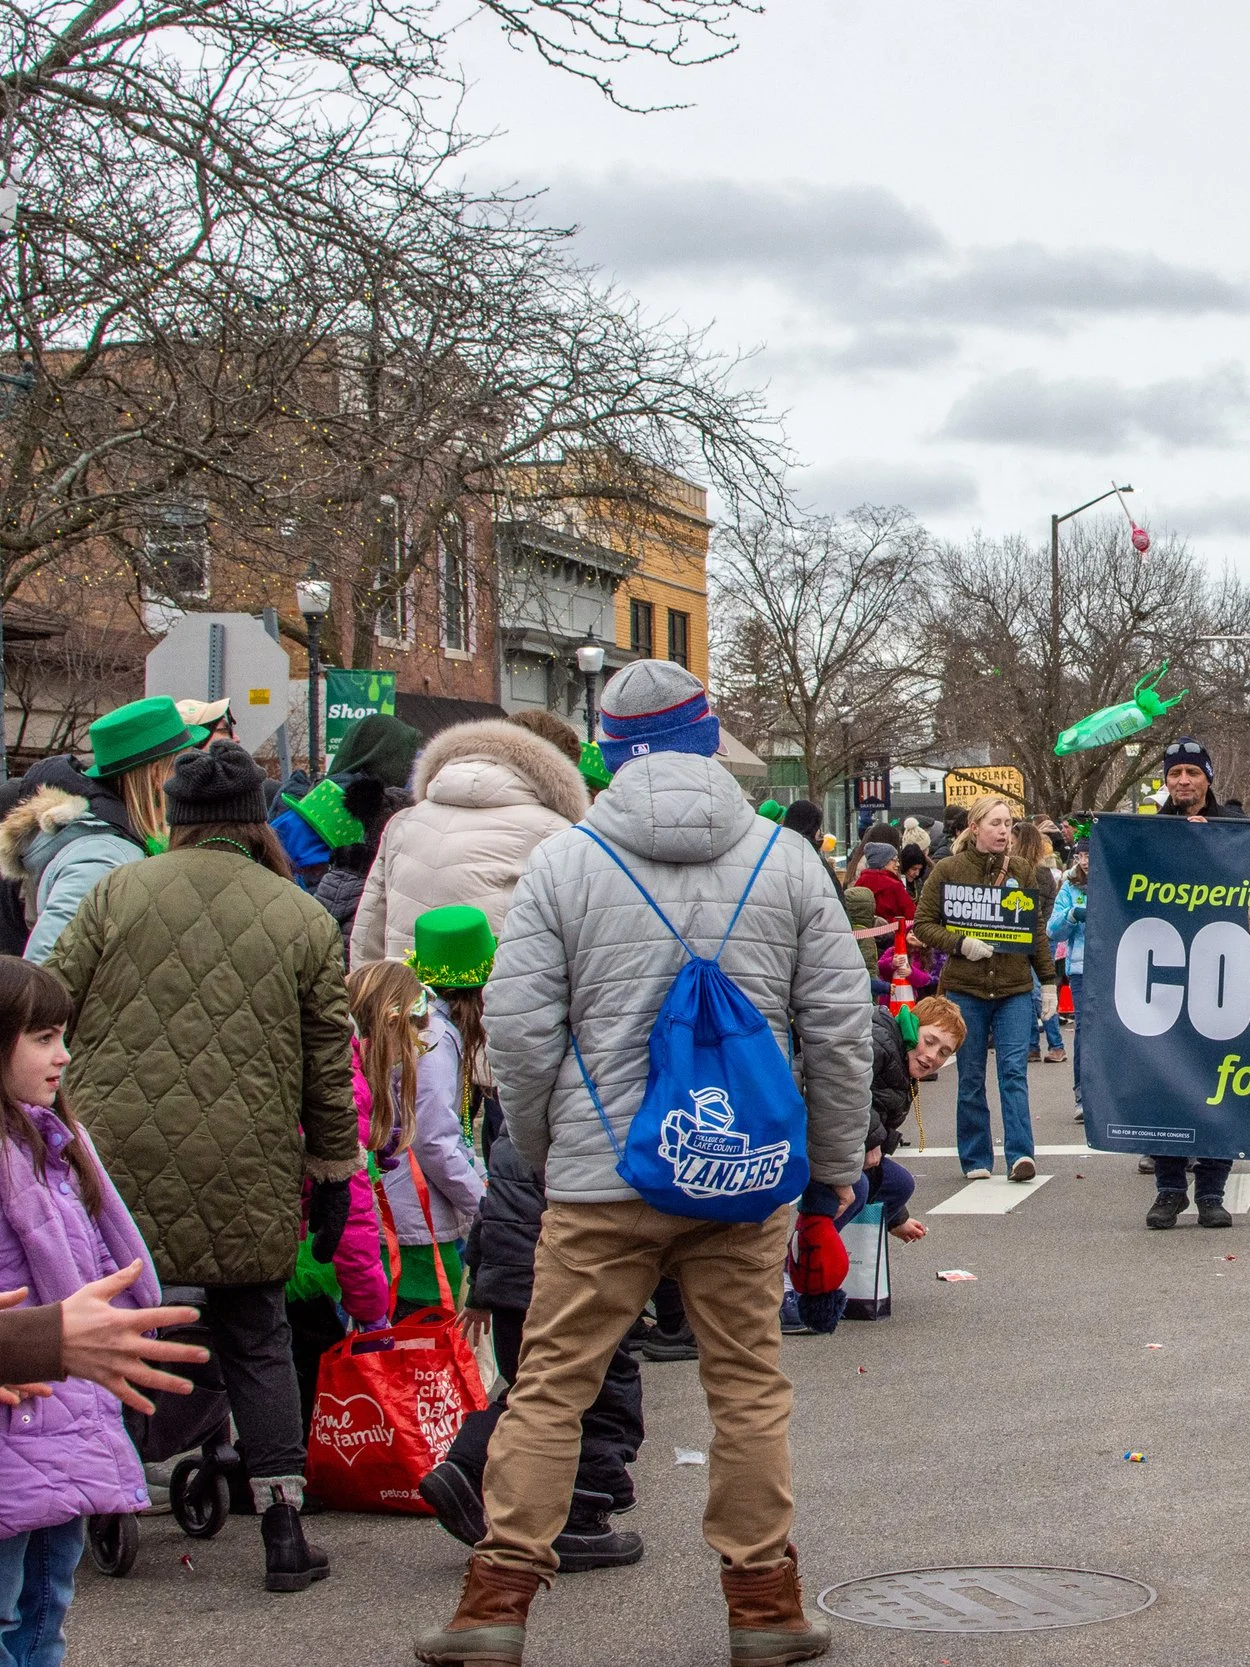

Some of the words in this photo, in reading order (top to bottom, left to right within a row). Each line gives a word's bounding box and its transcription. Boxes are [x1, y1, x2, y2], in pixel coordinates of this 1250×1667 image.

[949, 785, 977, 796] FEED
[944, 884, 1002, 904] MORGAN
[944, 900, 1004, 922] COGHILL
[972, 930, 994, 938] TUESDAY
[994, 932, 1012, 940] MARCH
[695, 1134, 719, 1143] COLLEGE
[692, 1140, 713, 1150] LAKE
[674, 1153, 787, 1193] LANCERS
[333, 1424, 395, 1447] family
[380, 1489, 410, 1500] petco
